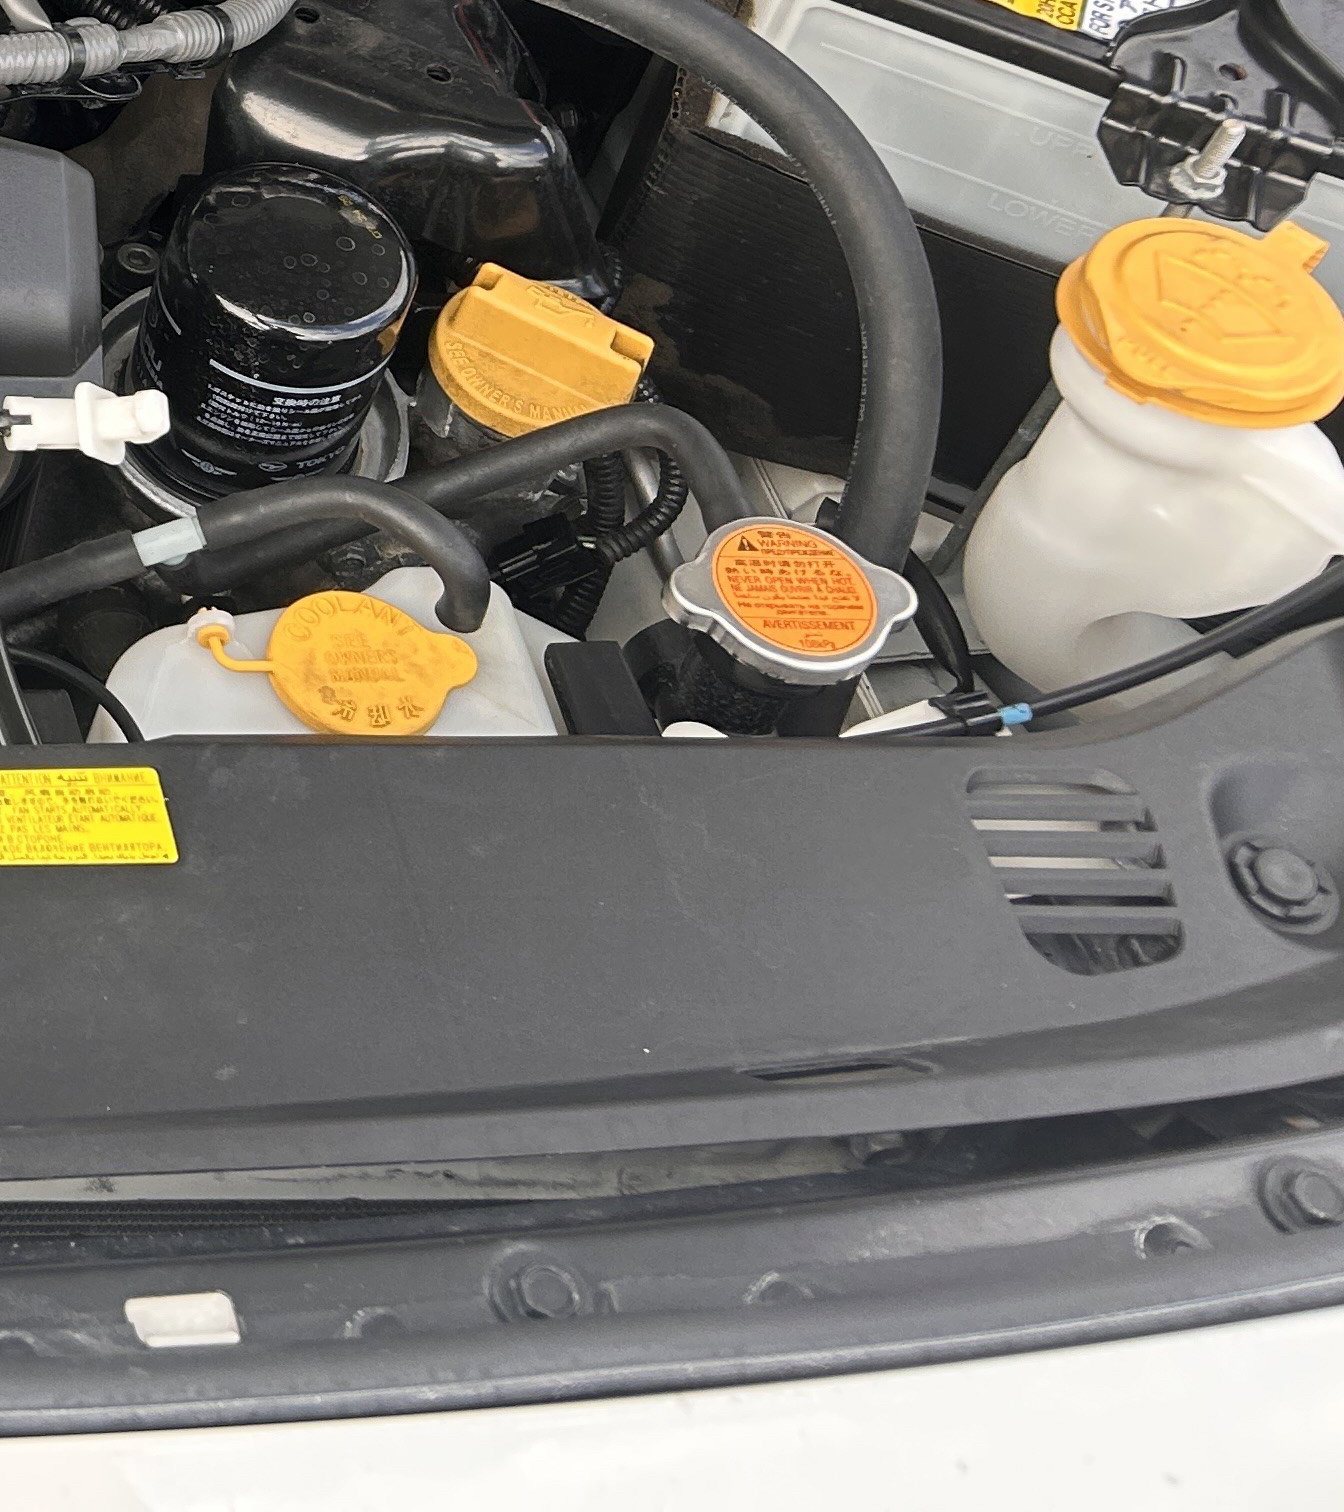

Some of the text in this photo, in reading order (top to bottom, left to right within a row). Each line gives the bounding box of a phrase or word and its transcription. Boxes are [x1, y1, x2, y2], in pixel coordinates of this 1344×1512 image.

[1056, 0, 1078, 26] CCA
[1089, 7, 1113, 35] FOR
[757, 539, 817, 548] WARNING
[727, 575, 761, 583] NEVER
[796, 577, 828, 585] WHEN
[283, 595, 423, 642] COOLANT
[763, 620, 856, 630] AVERTISSEMENT
[0, 773, 52, 785] ATTENTION
